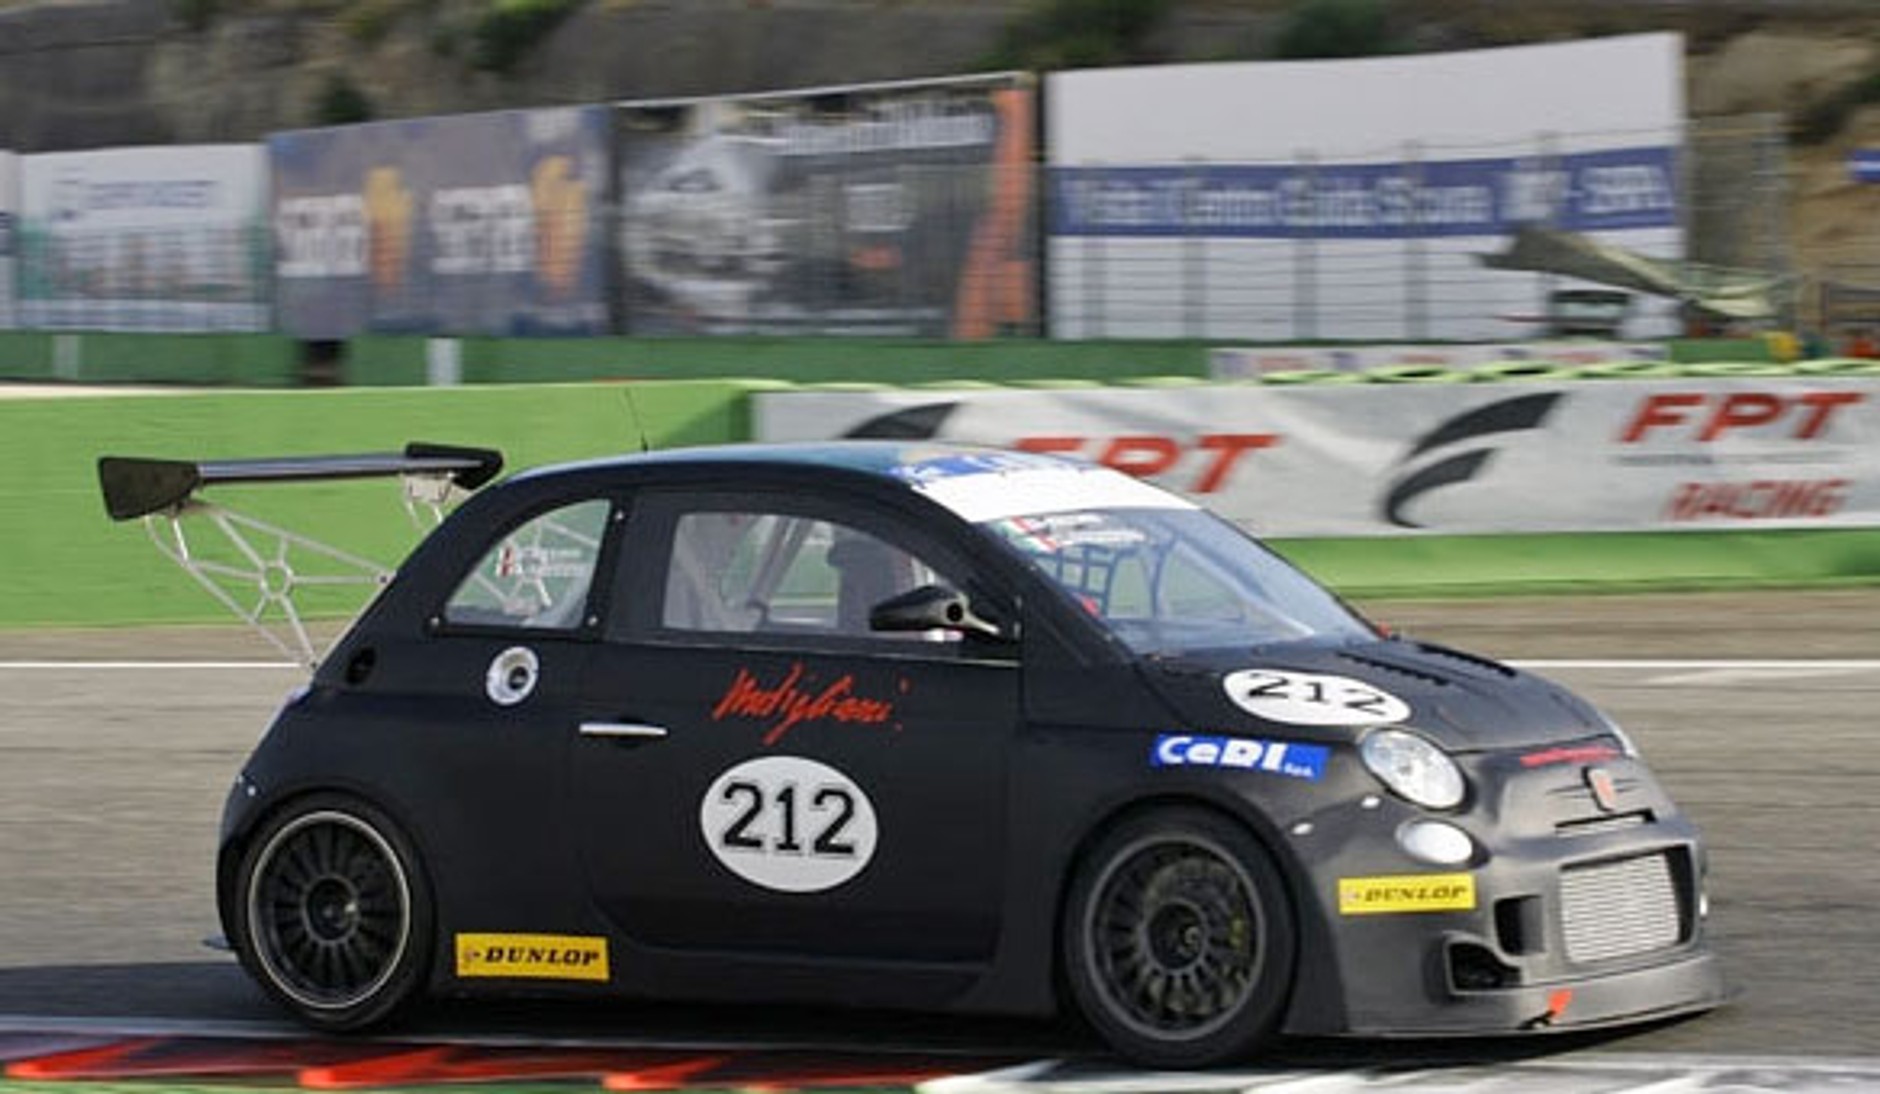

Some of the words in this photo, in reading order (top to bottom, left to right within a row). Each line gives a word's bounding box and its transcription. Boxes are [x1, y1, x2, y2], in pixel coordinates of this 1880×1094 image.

[1618, 392, 1868, 442] FPT
[1662, 480, 1854, 521] RACING
[1247, 673, 1386, 716] 212
[722, 781, 856, 855] 212
[1364, 885, 1467, 902] DUNLOP
[486, 946, 600, 966] DUNLOP
